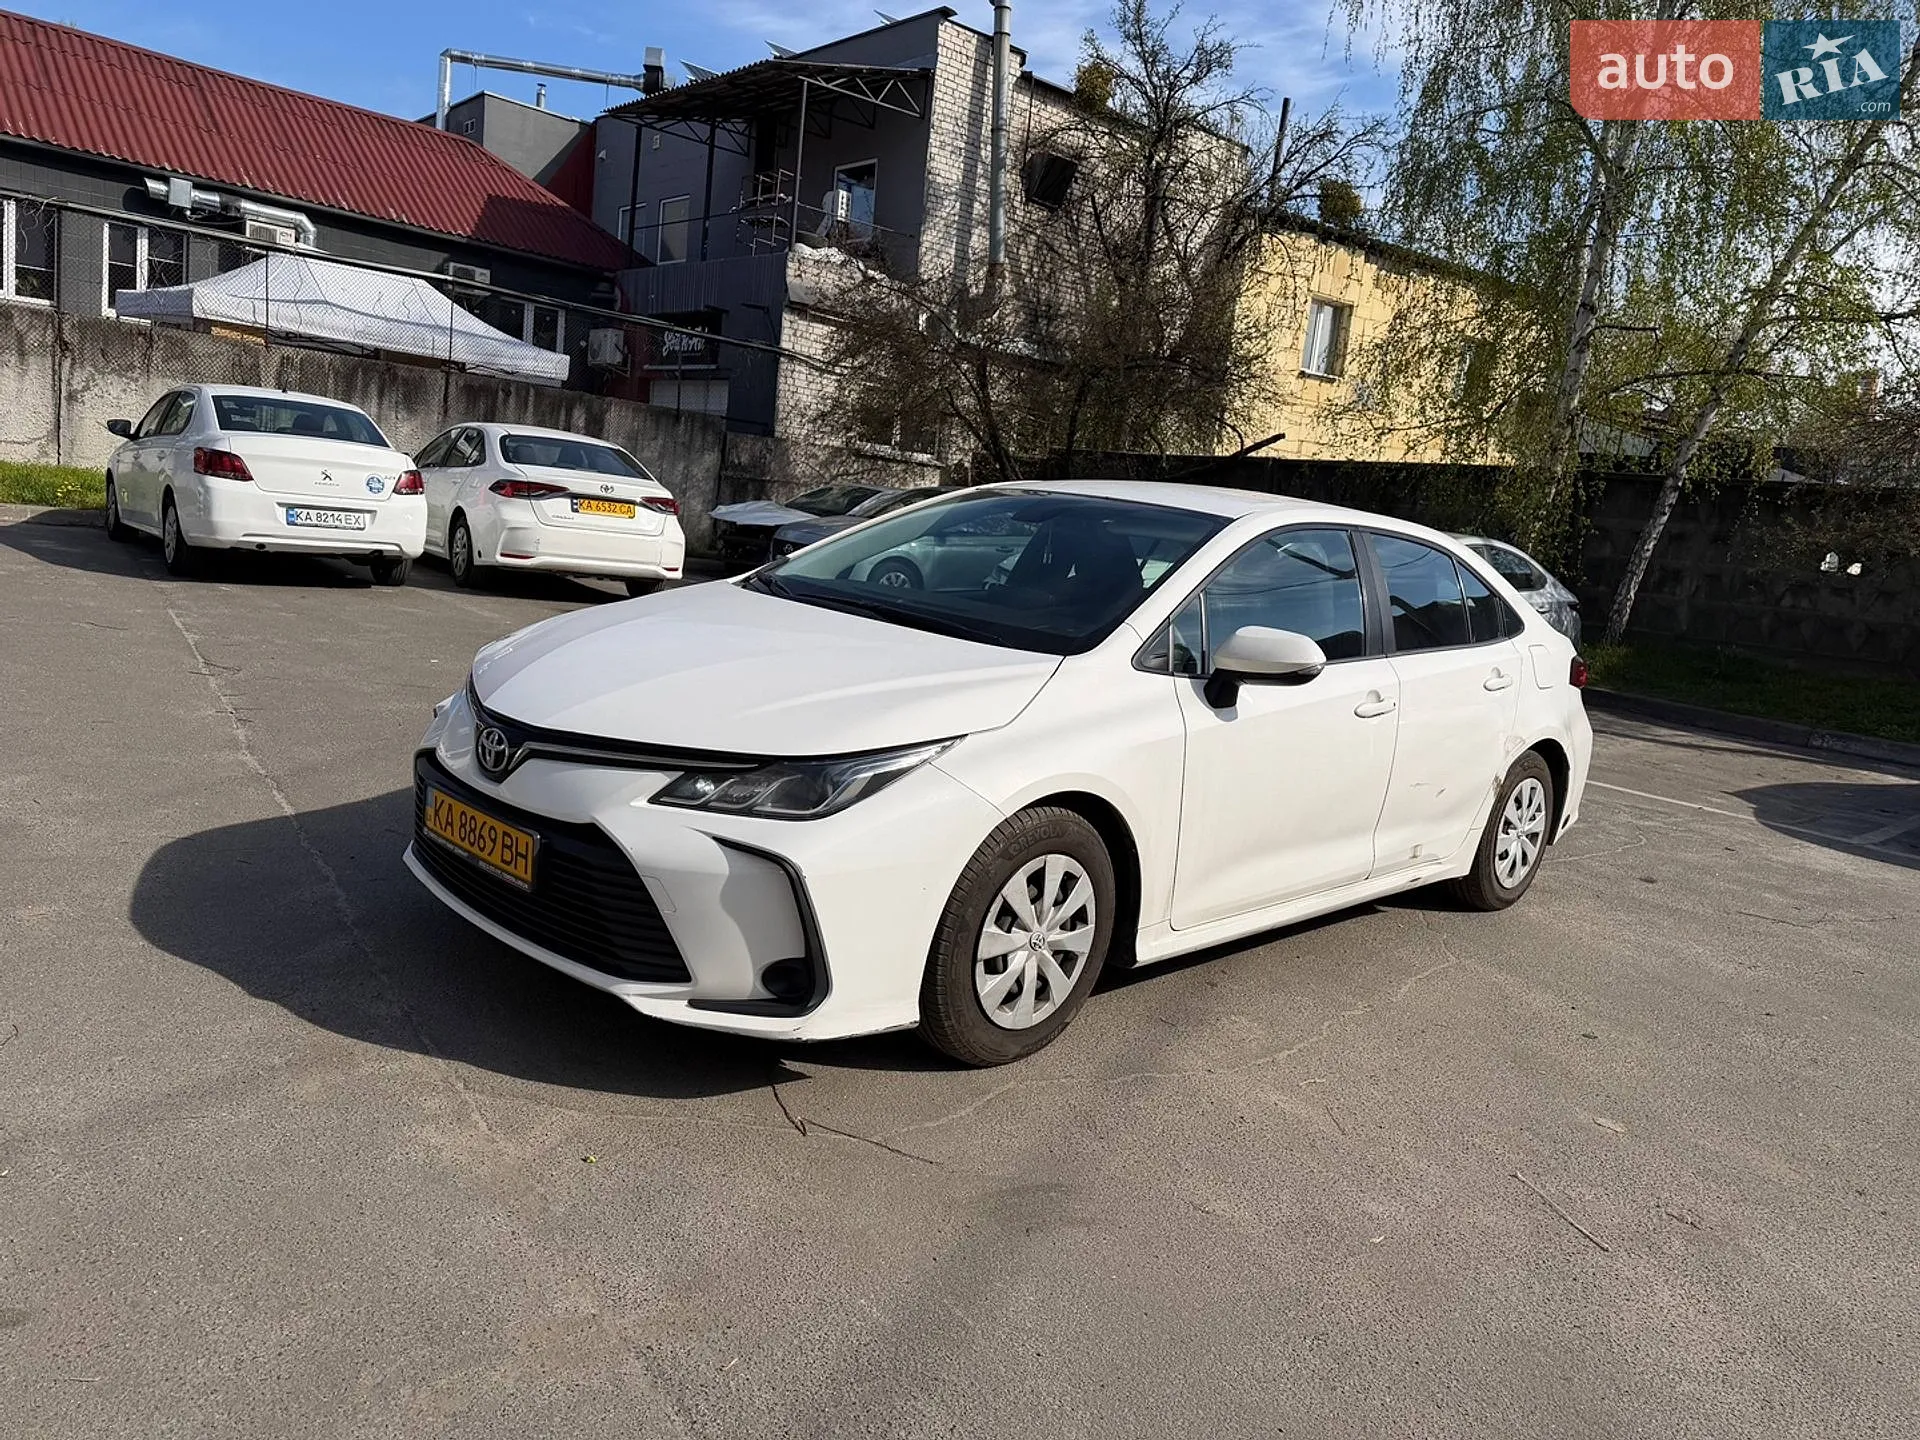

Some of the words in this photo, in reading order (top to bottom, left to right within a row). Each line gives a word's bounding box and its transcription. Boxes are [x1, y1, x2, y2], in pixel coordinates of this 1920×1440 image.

[296, 510, 313, 522] KA
[316, 512, 342, 524] 8214
[344, 514, 361, 526] EX
[433, 795, 455, 837] KA
[458, 810, 498, 857] 8869
[500, 830, 530, 875] BH
